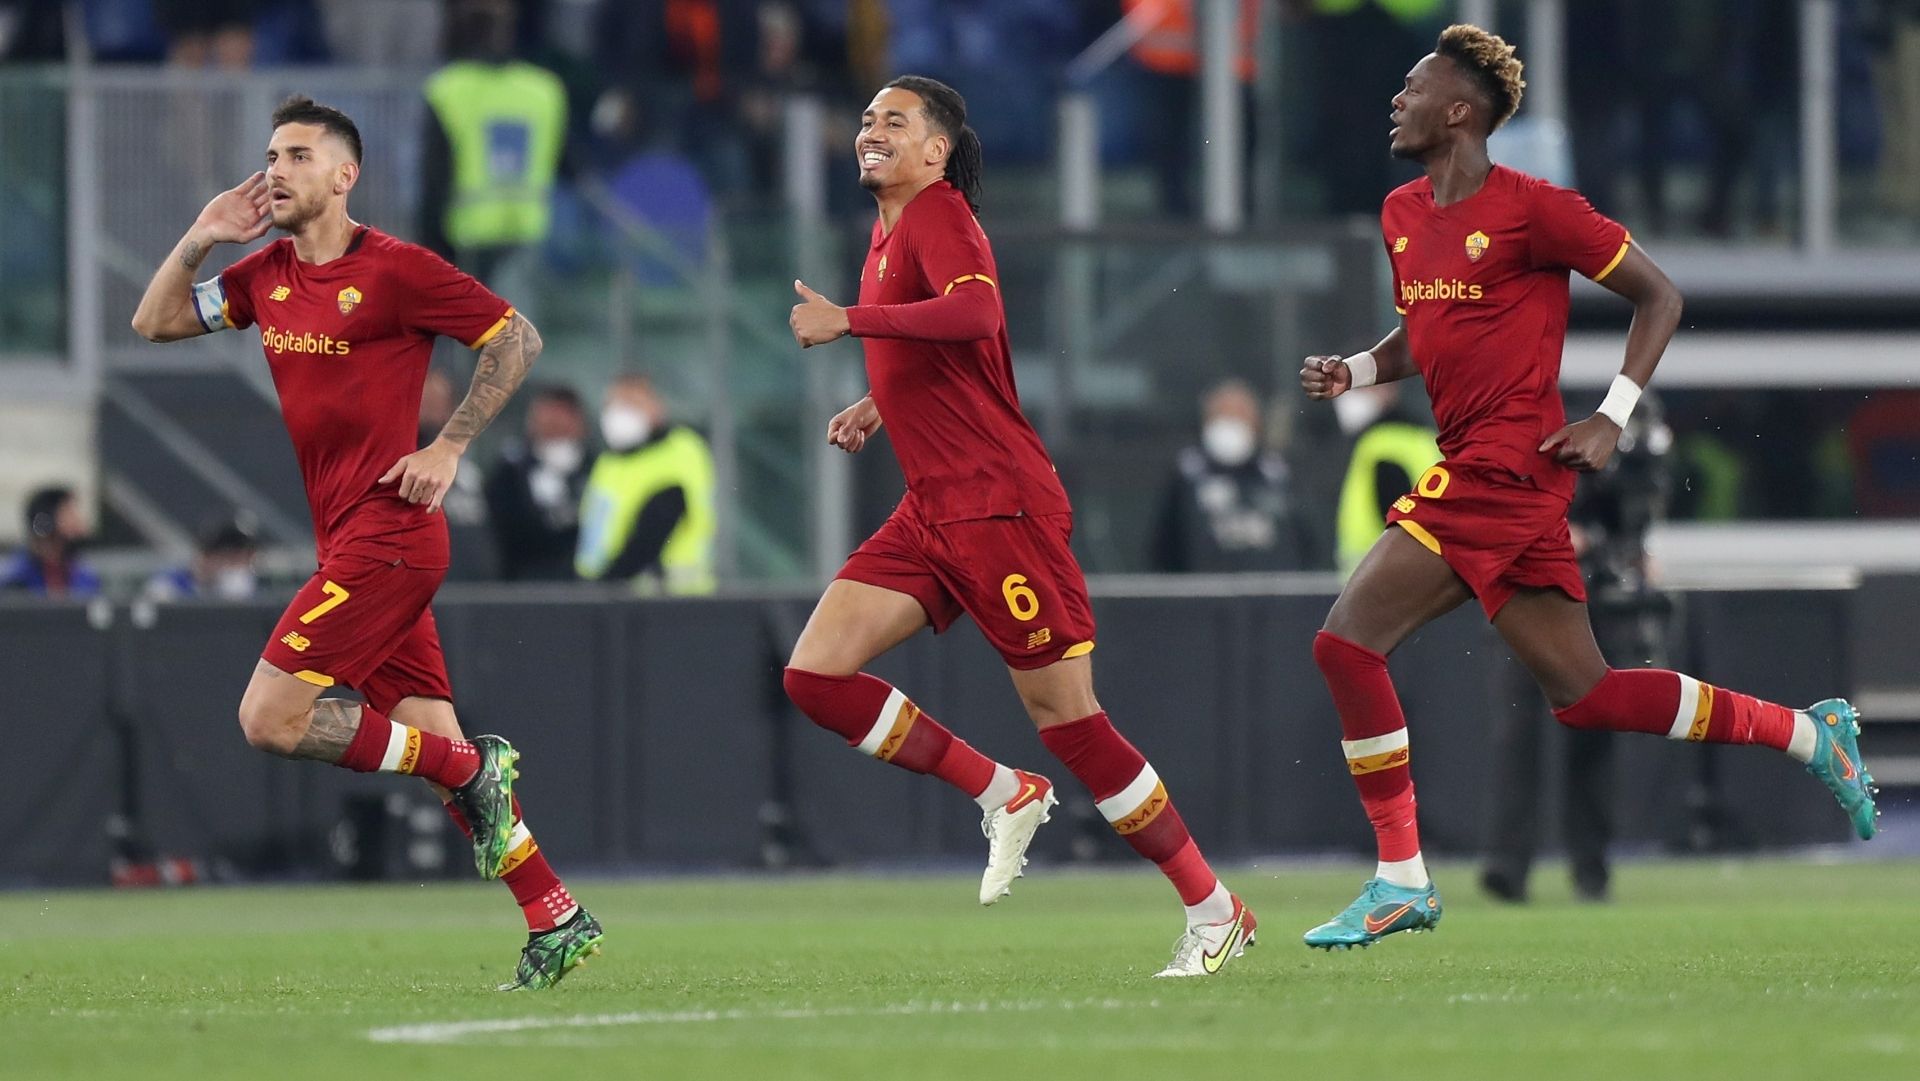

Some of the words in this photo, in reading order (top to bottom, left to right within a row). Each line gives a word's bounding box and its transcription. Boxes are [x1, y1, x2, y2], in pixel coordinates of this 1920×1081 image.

[262, 326, 350, 355] digitalbits
[299, 580, 350, 625] 7
[1002, 573, 1039, 621] 6
[401, 734, 417, 772] OMA
[1114, 798, 1163, 832] OMA
